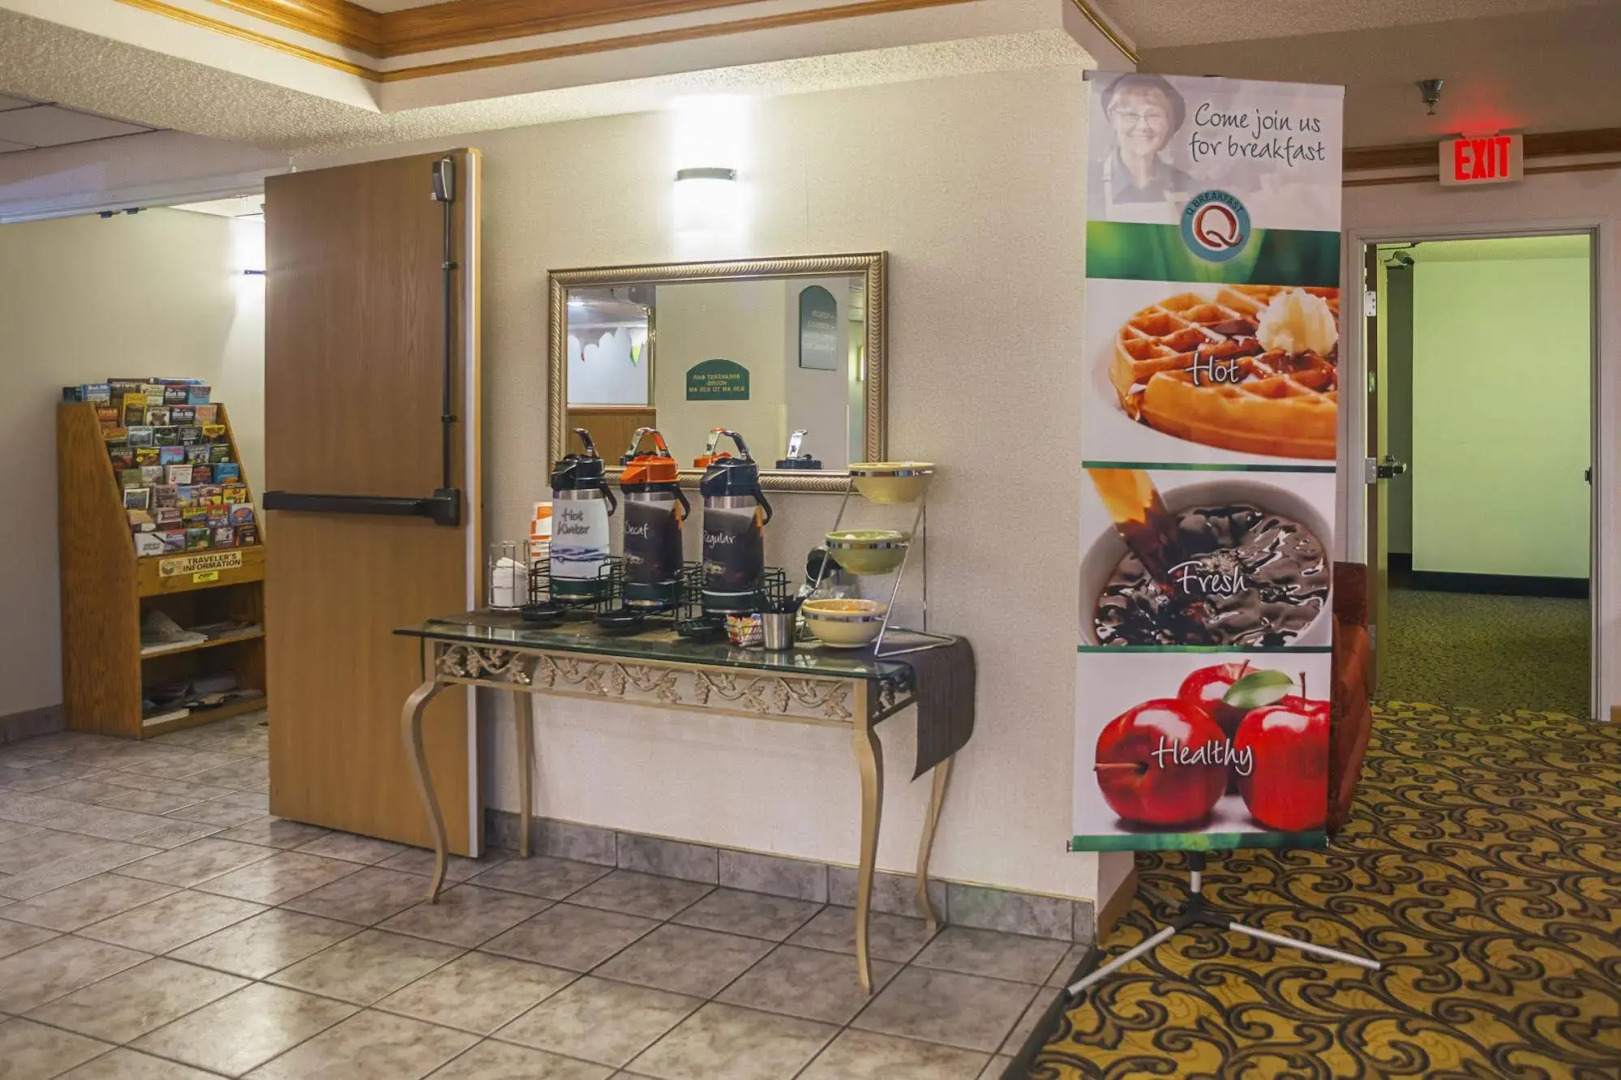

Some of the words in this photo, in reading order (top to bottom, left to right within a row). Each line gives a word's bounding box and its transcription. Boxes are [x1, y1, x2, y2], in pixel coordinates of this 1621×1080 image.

[1195, 102, 1250, 129] Come
[1252, 108, 1292, 139] join
[1299, 114, 1321, 133] us
[1189, 132, 1222, 162] for
[1228, 135, 1325, 167] breakfast
[1454, 136, 1511, 180] EXIT
[1192, 191, 1244, 214] BREAKFAST
[1194, 204, 1243, 248] Q
[1185, 352, 1239, 386] Hot
[557, 521, 591, 536] Water
[561, 507, 584, 522] Hot
[182, 559, 241, 572] INFORMATION
[187, 552, 237, 565] TRAVELER'S
[1167, 560, 1248, 594] Fresh
[1150, 735, 1253, 776] Healthy
